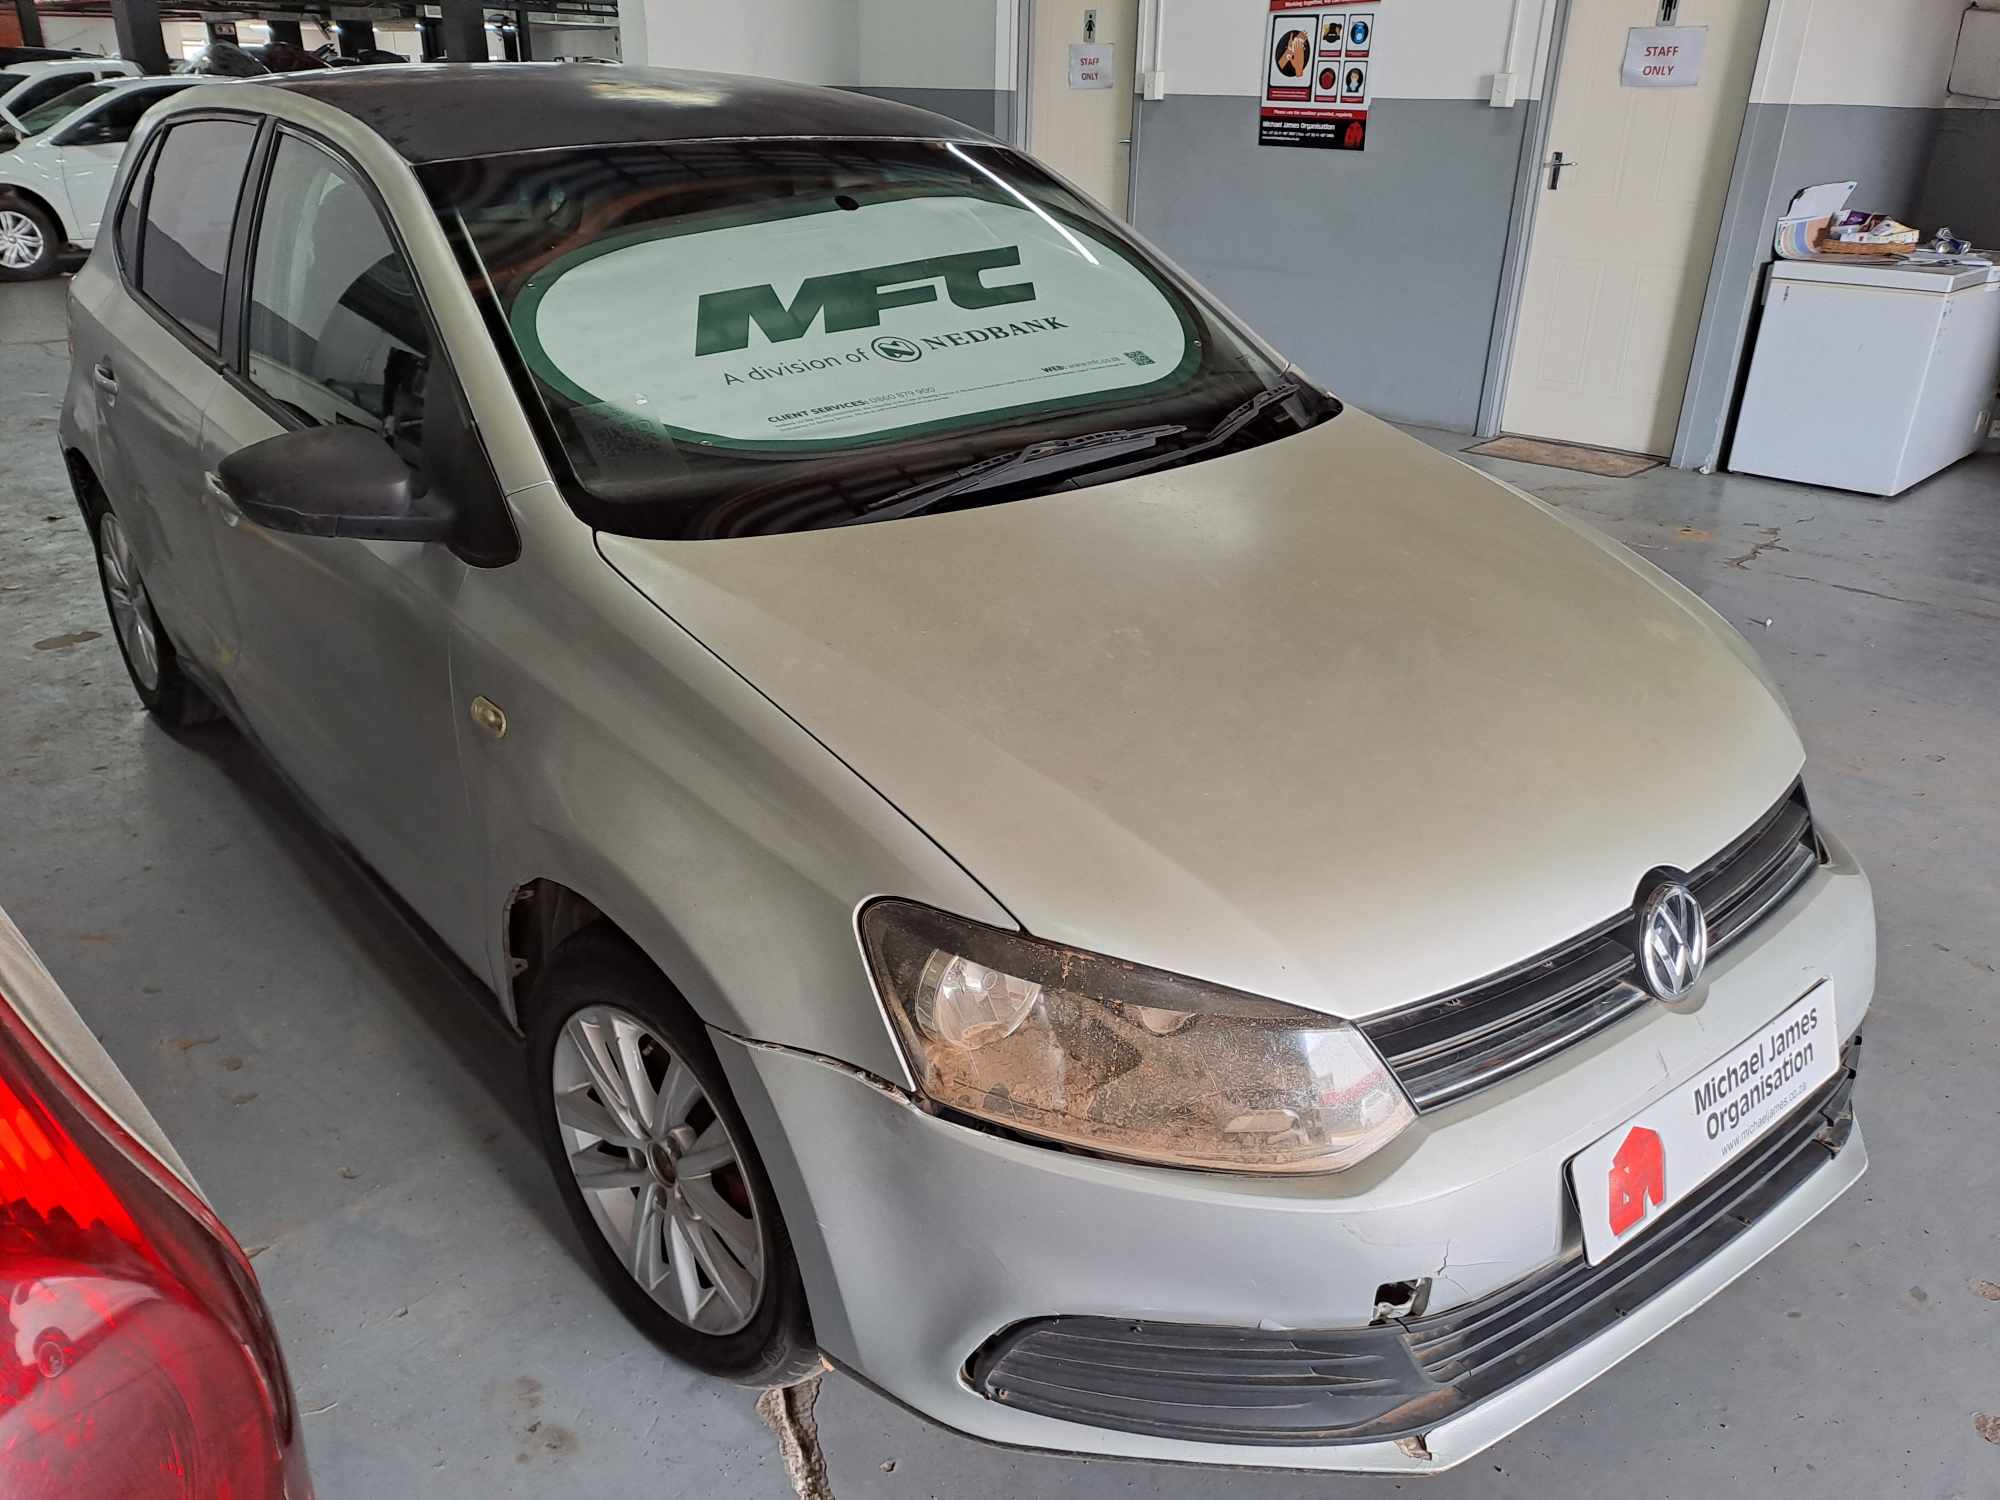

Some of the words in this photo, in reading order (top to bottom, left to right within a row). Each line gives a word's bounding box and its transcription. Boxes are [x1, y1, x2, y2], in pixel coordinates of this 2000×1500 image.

[1644, 46, 1679, 57] STAFF
[1080, 57, 1099, 66] STAFF
[1081, 72, 1099, 81] ONLY
[1642, 64, 1674, 77] ONLY
[695, 245, 1036, 357] MFC
[723, 372, 745, 386] A
[748, 356, 842, 381] division
[846, 347, 870, 363] of
[920, 316, 1068, 350] NEDBANK
[767, 409, 811, 423] CLIENT
[1694, 1047, 1765, 1116] Michael
[1768, 1006, 1818, 1063] James
[1706, 1041, 1814, 1141] Organisation
